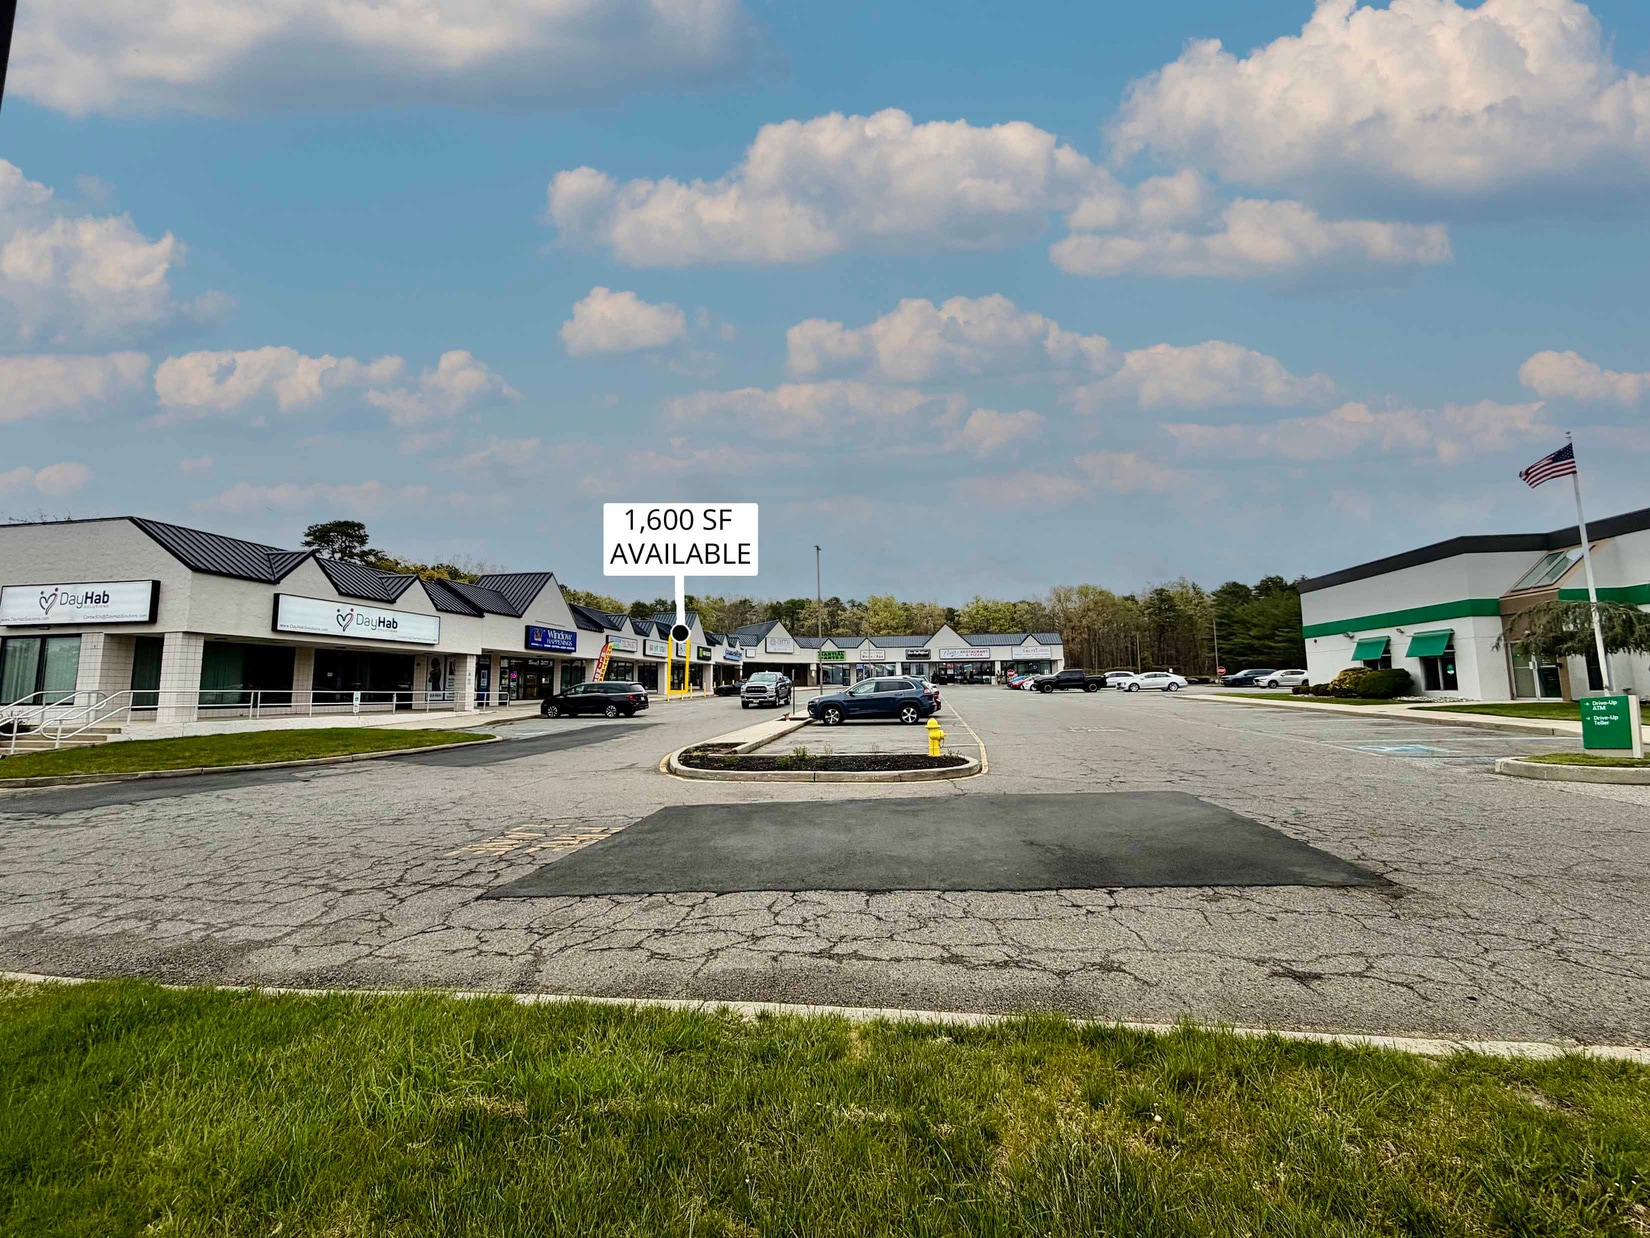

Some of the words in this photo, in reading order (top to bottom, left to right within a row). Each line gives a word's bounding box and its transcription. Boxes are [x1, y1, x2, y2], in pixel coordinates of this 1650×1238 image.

[59, 590, 110, 609] DayHab
[356, 613, 398, 631] DayHab
[547, 629, 573, 641] Window
